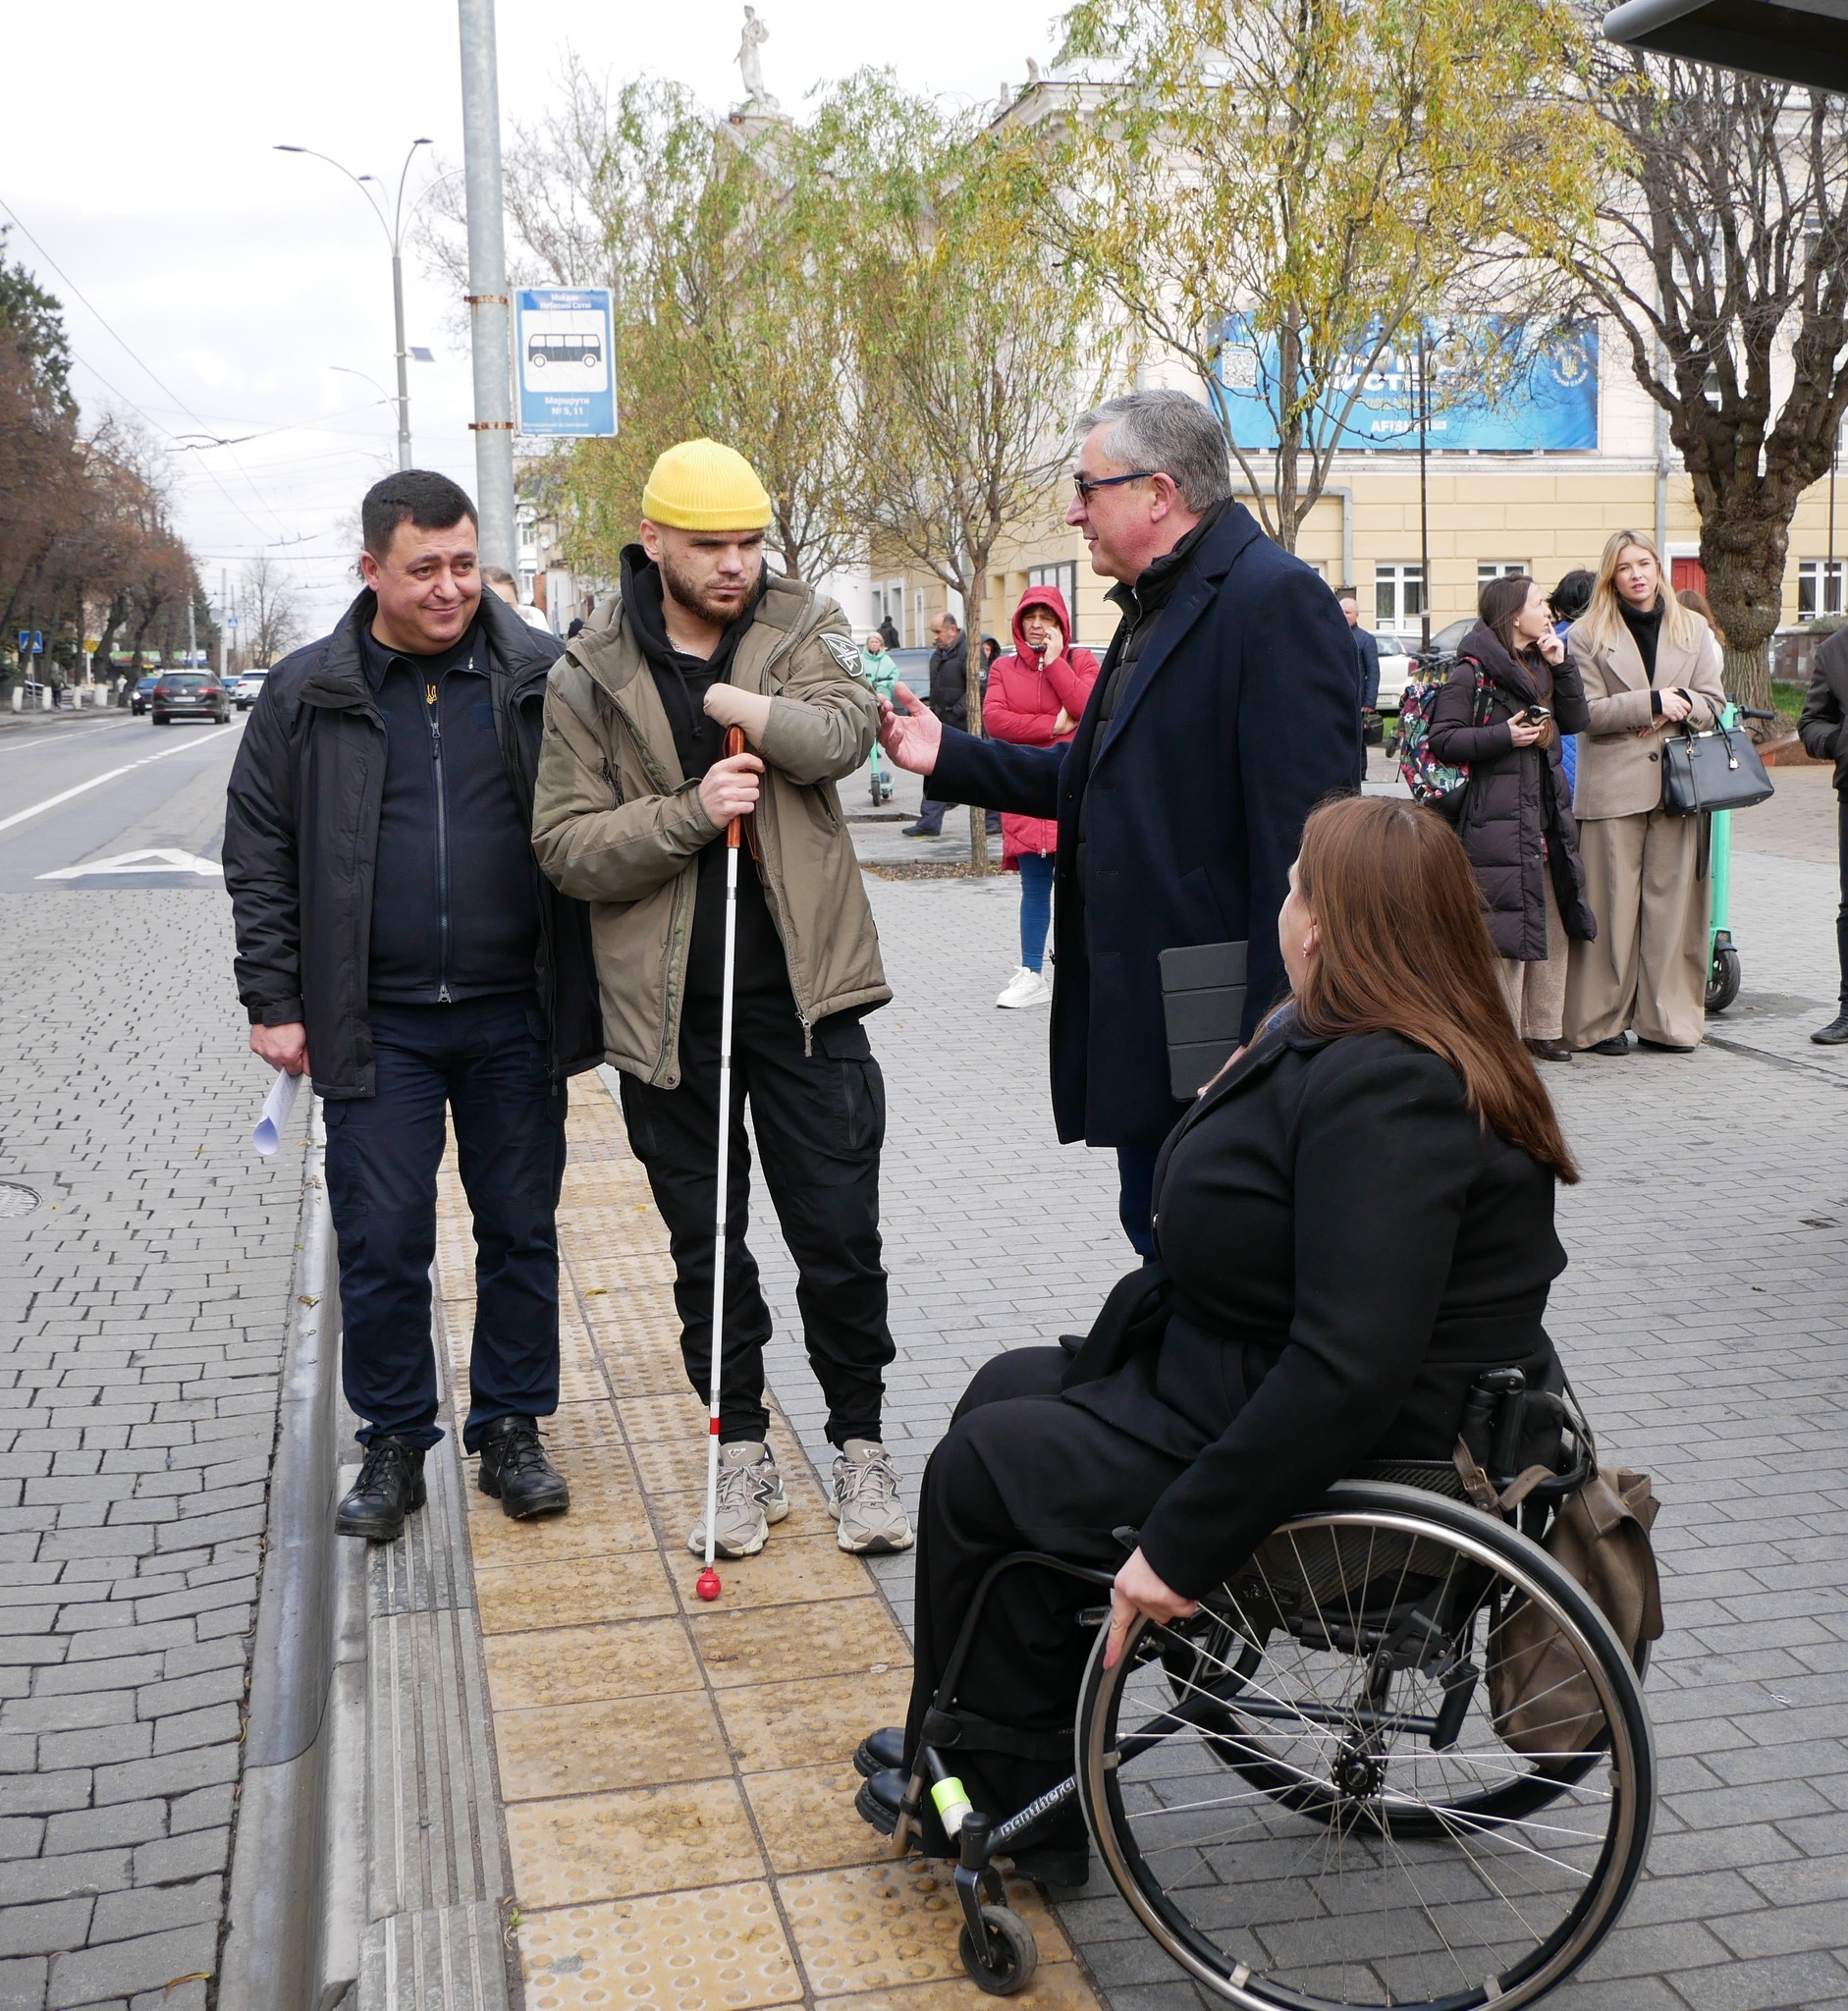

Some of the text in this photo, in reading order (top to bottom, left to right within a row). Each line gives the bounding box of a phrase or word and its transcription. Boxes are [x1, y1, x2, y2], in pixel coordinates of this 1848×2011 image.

[551, 294, 579, 302] Майдан
[545, 397, 589, 406] Маршрути
[564, 408, 572, 416] 5,
[1001, 1776, 1077, 1837] panthera
